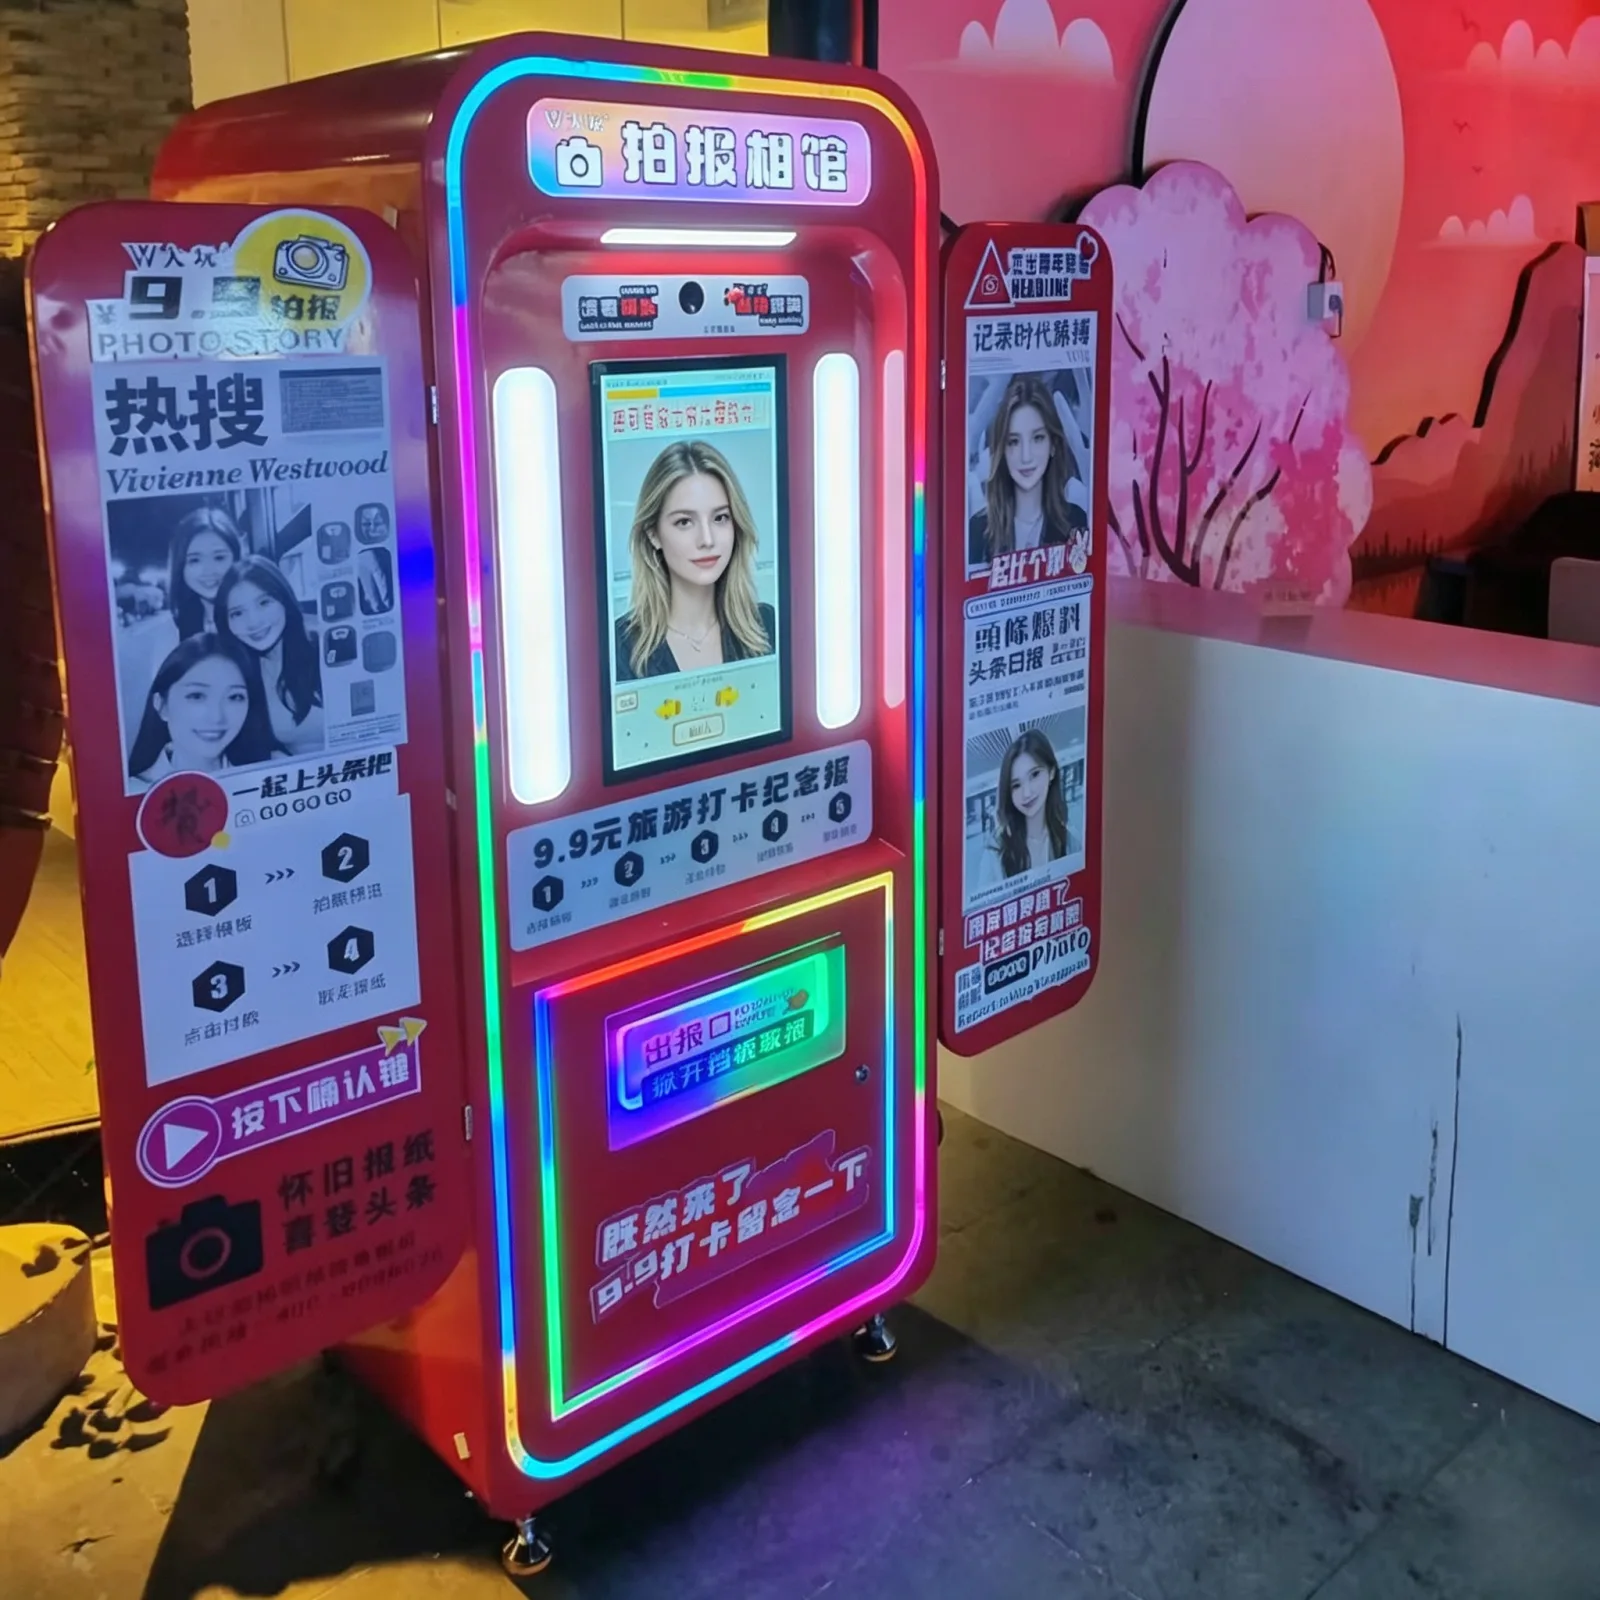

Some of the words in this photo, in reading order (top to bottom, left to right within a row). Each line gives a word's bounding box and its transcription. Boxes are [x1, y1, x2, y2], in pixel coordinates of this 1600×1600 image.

[620, 121, 848, 192] 拍报相馆
[1011, 277, 1070, 299] HEADLINE
[99, 331, 222, 355] PHOTO
[233, 328, 344, 353] STORY
[105, 373, 268, 456] 热搜
[106, 466, 242, 494] Vivienne
[249, 451, 388, 482] Westwood
[260, 802, 288, 820] GO
[292, 795, 320, 813] GO
[325, 788, 352, 806] GO
[533, 756, 850, 869] 9.9元旅游打卡纪念报
[337, 846, 353, 871] 2
[203, 877, 217, 903] 1
[344, 938, 360, 962] 4
[210, 974, 228, 999] 3
[645, 1011, 731, 1068] 出报口
[231, 1053, 409, 1140] 按下确认键
[277, 1129, 435, 1211] 怀旧报纸
[597, 1152, 867, 1314] 9.9打卡留念一下
[603, 1164, 750, 1262] 既然来了
